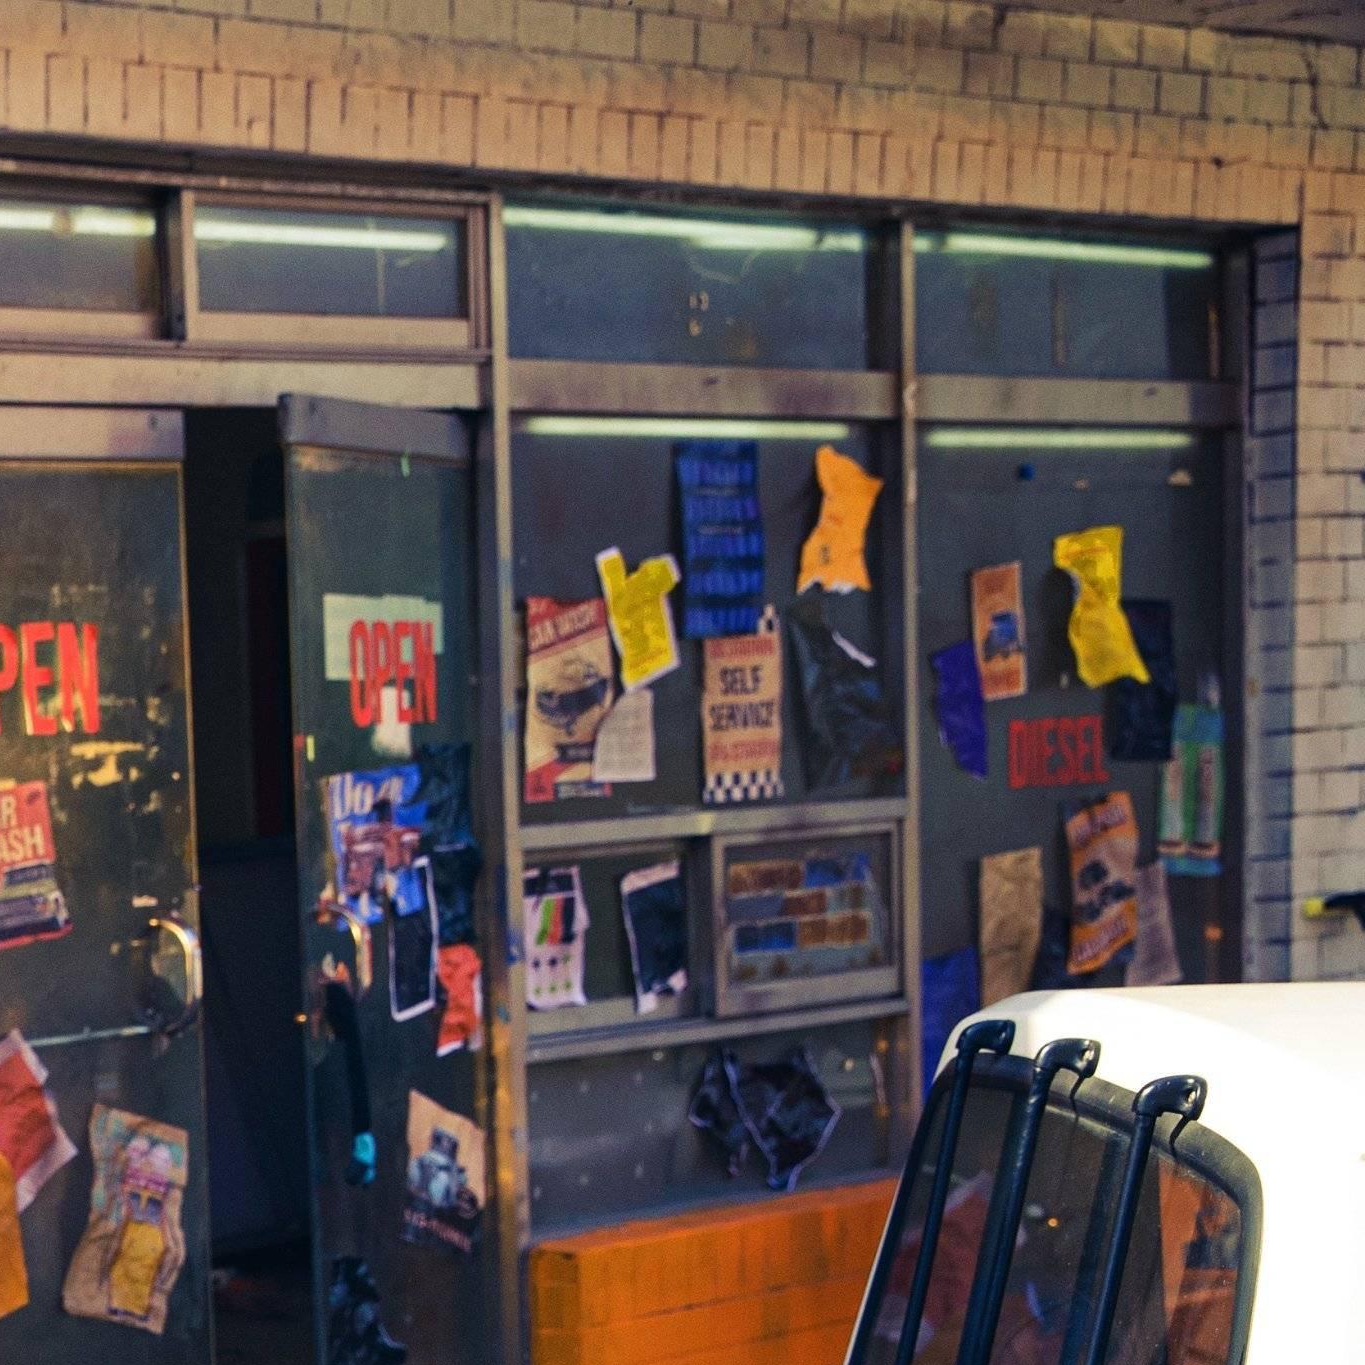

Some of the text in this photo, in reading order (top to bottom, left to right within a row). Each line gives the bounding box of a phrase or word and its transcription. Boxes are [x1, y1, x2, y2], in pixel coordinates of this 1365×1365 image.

[349, 618, 438, 728] OPEN
[719, 665, 762, 696] SELF
[709, 700, 775, 732] SERVICE
[1007, 714, 1110, 790] DIESEL
